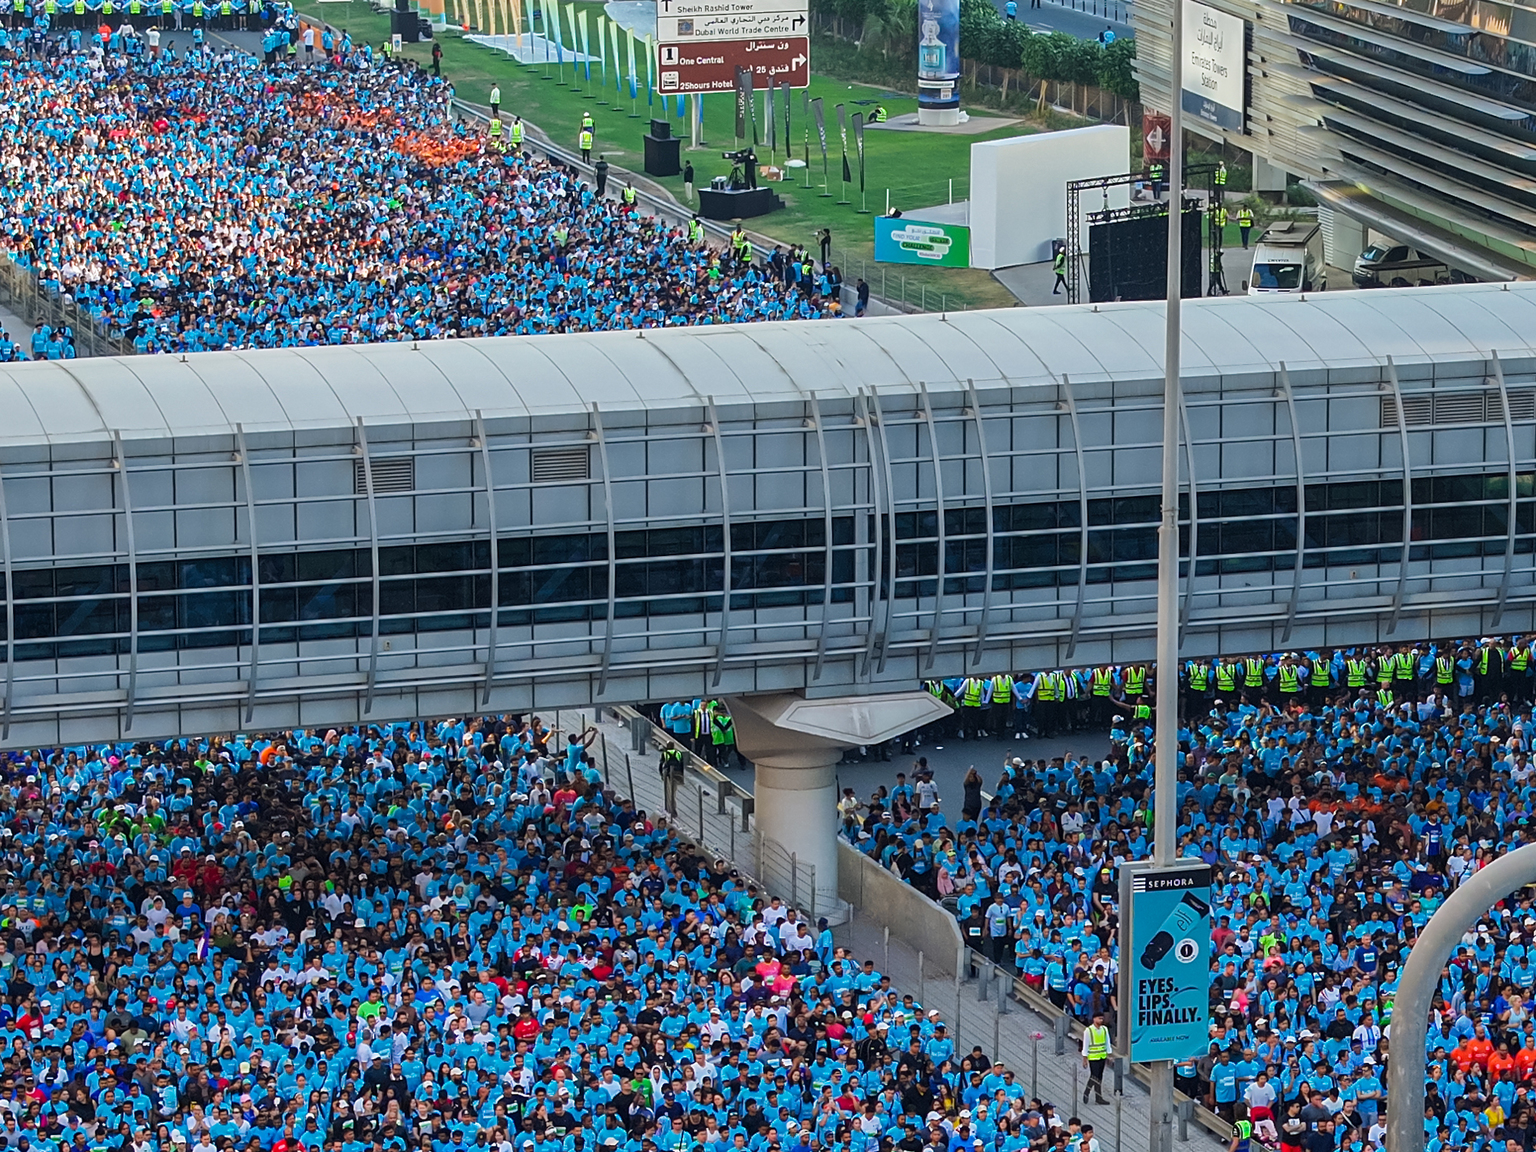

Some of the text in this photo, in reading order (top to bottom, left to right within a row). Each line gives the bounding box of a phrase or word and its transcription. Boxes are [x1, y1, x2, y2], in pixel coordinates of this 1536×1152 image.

[677, 3, 754, 14] Sheikh Rashid Tower
[695, 25, 790, 37] Dubai World Trade Centre
[679, 56, 725, 66] One Central
[1191, 51, 1228, 78] Emirates Towers
[679, 79, 734, 91] 25hours Hotel
[1201, 72, 1218, 91] Station
[1148, 877, 1195, 889] SEPHORA
[1138, 976, 1179, 995] EYES.
[1138, 993, 1175, 1011] LIPS.
[1138, 1007, 1202, 1027] FINALLY.
